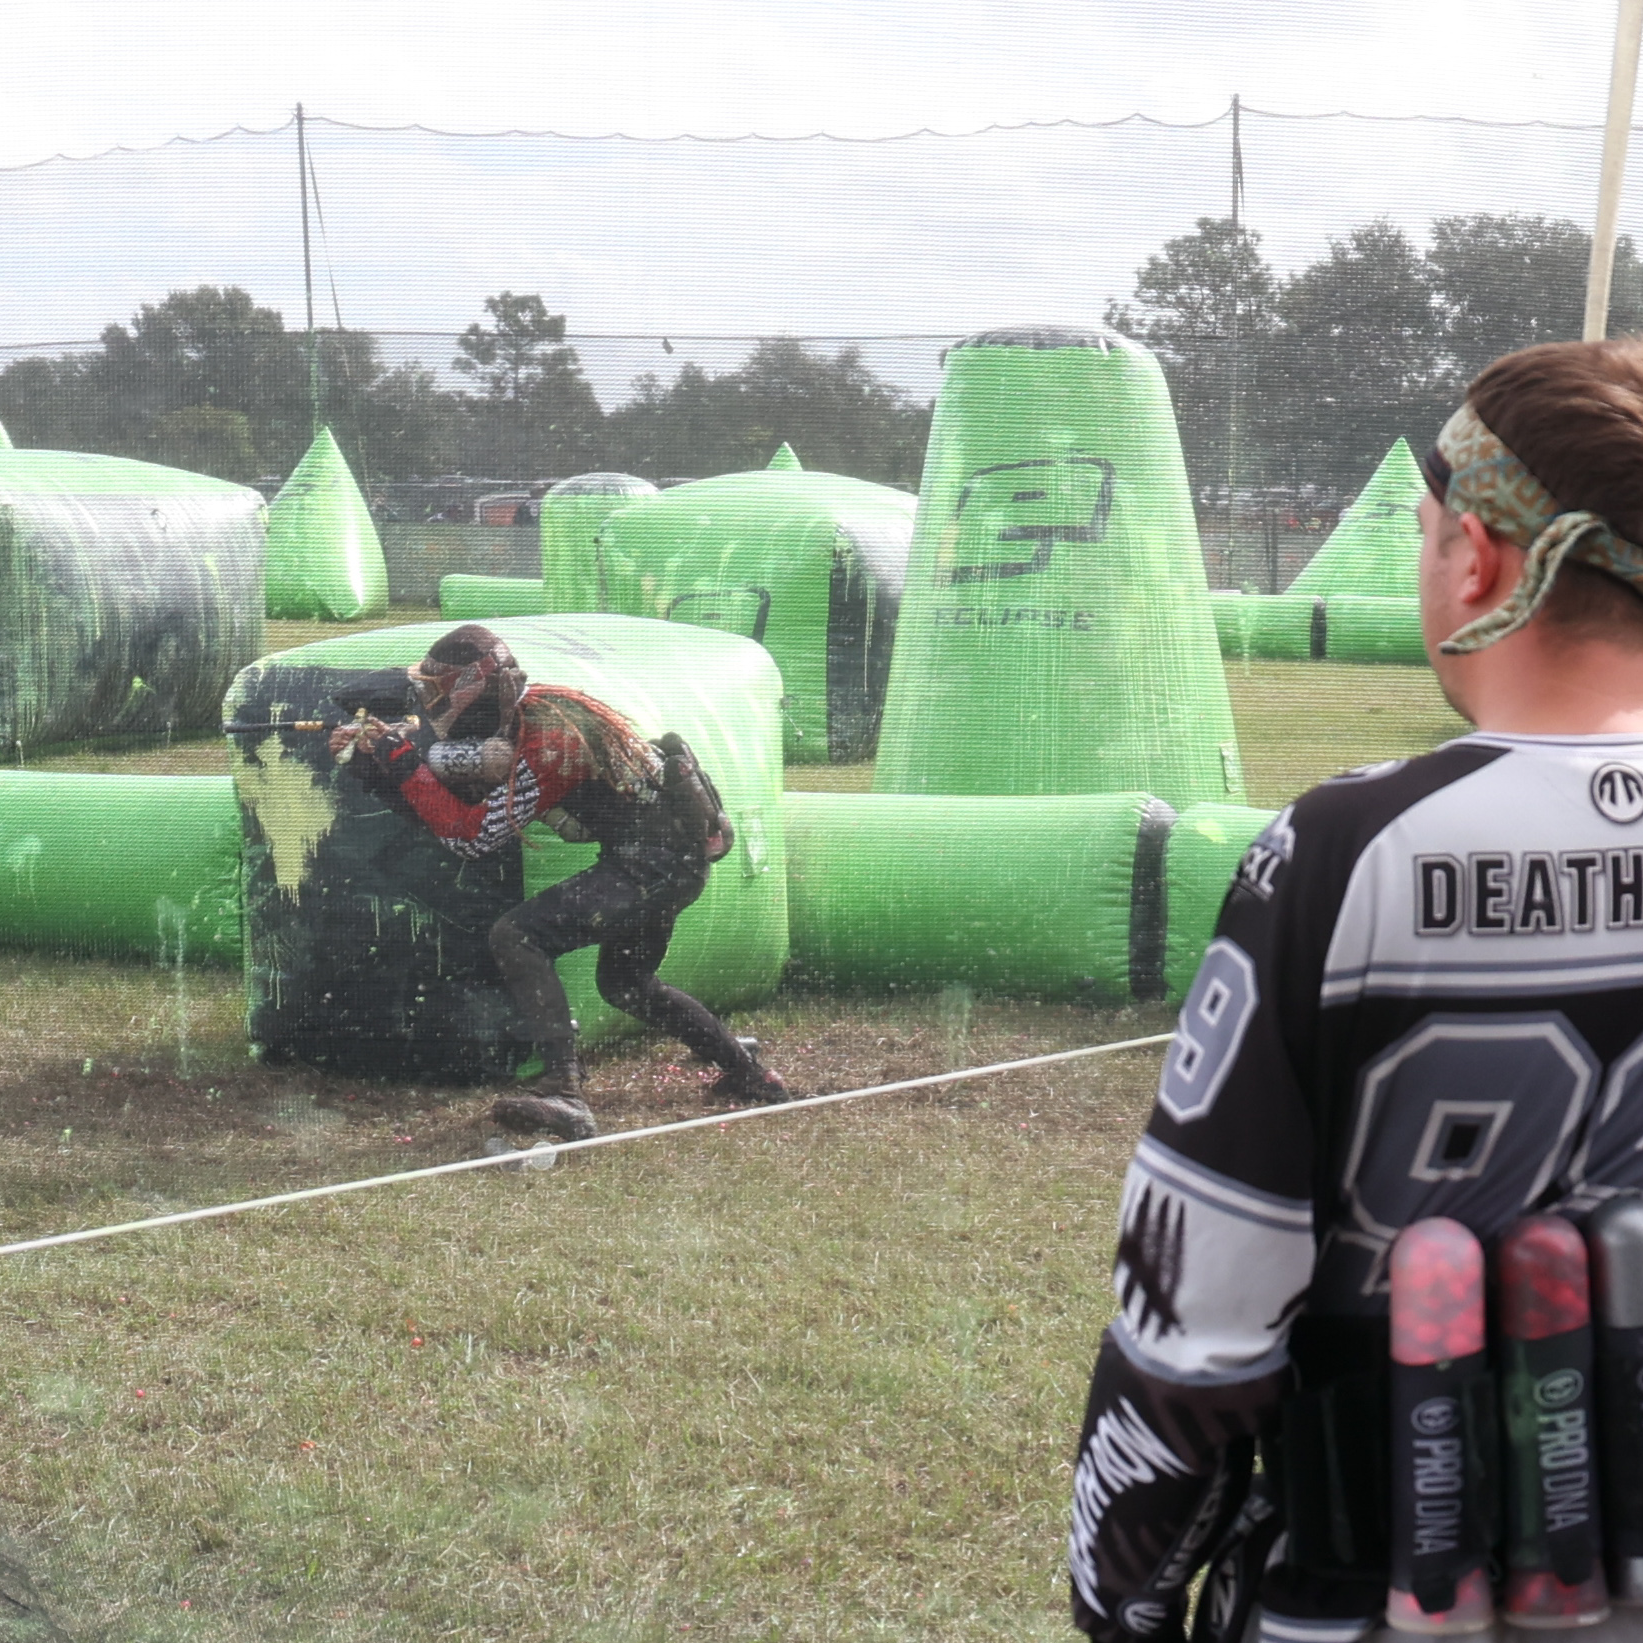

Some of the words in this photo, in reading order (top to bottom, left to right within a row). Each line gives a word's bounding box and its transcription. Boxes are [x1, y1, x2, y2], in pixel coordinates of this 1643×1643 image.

[1412, 1437, 1463, 1495] PRO
[1536, 1409, 1589, 1470] PRO
[1413, 1499, 1461, 1556] DNA
[1543, 1471, 1590, 1533] DNA
